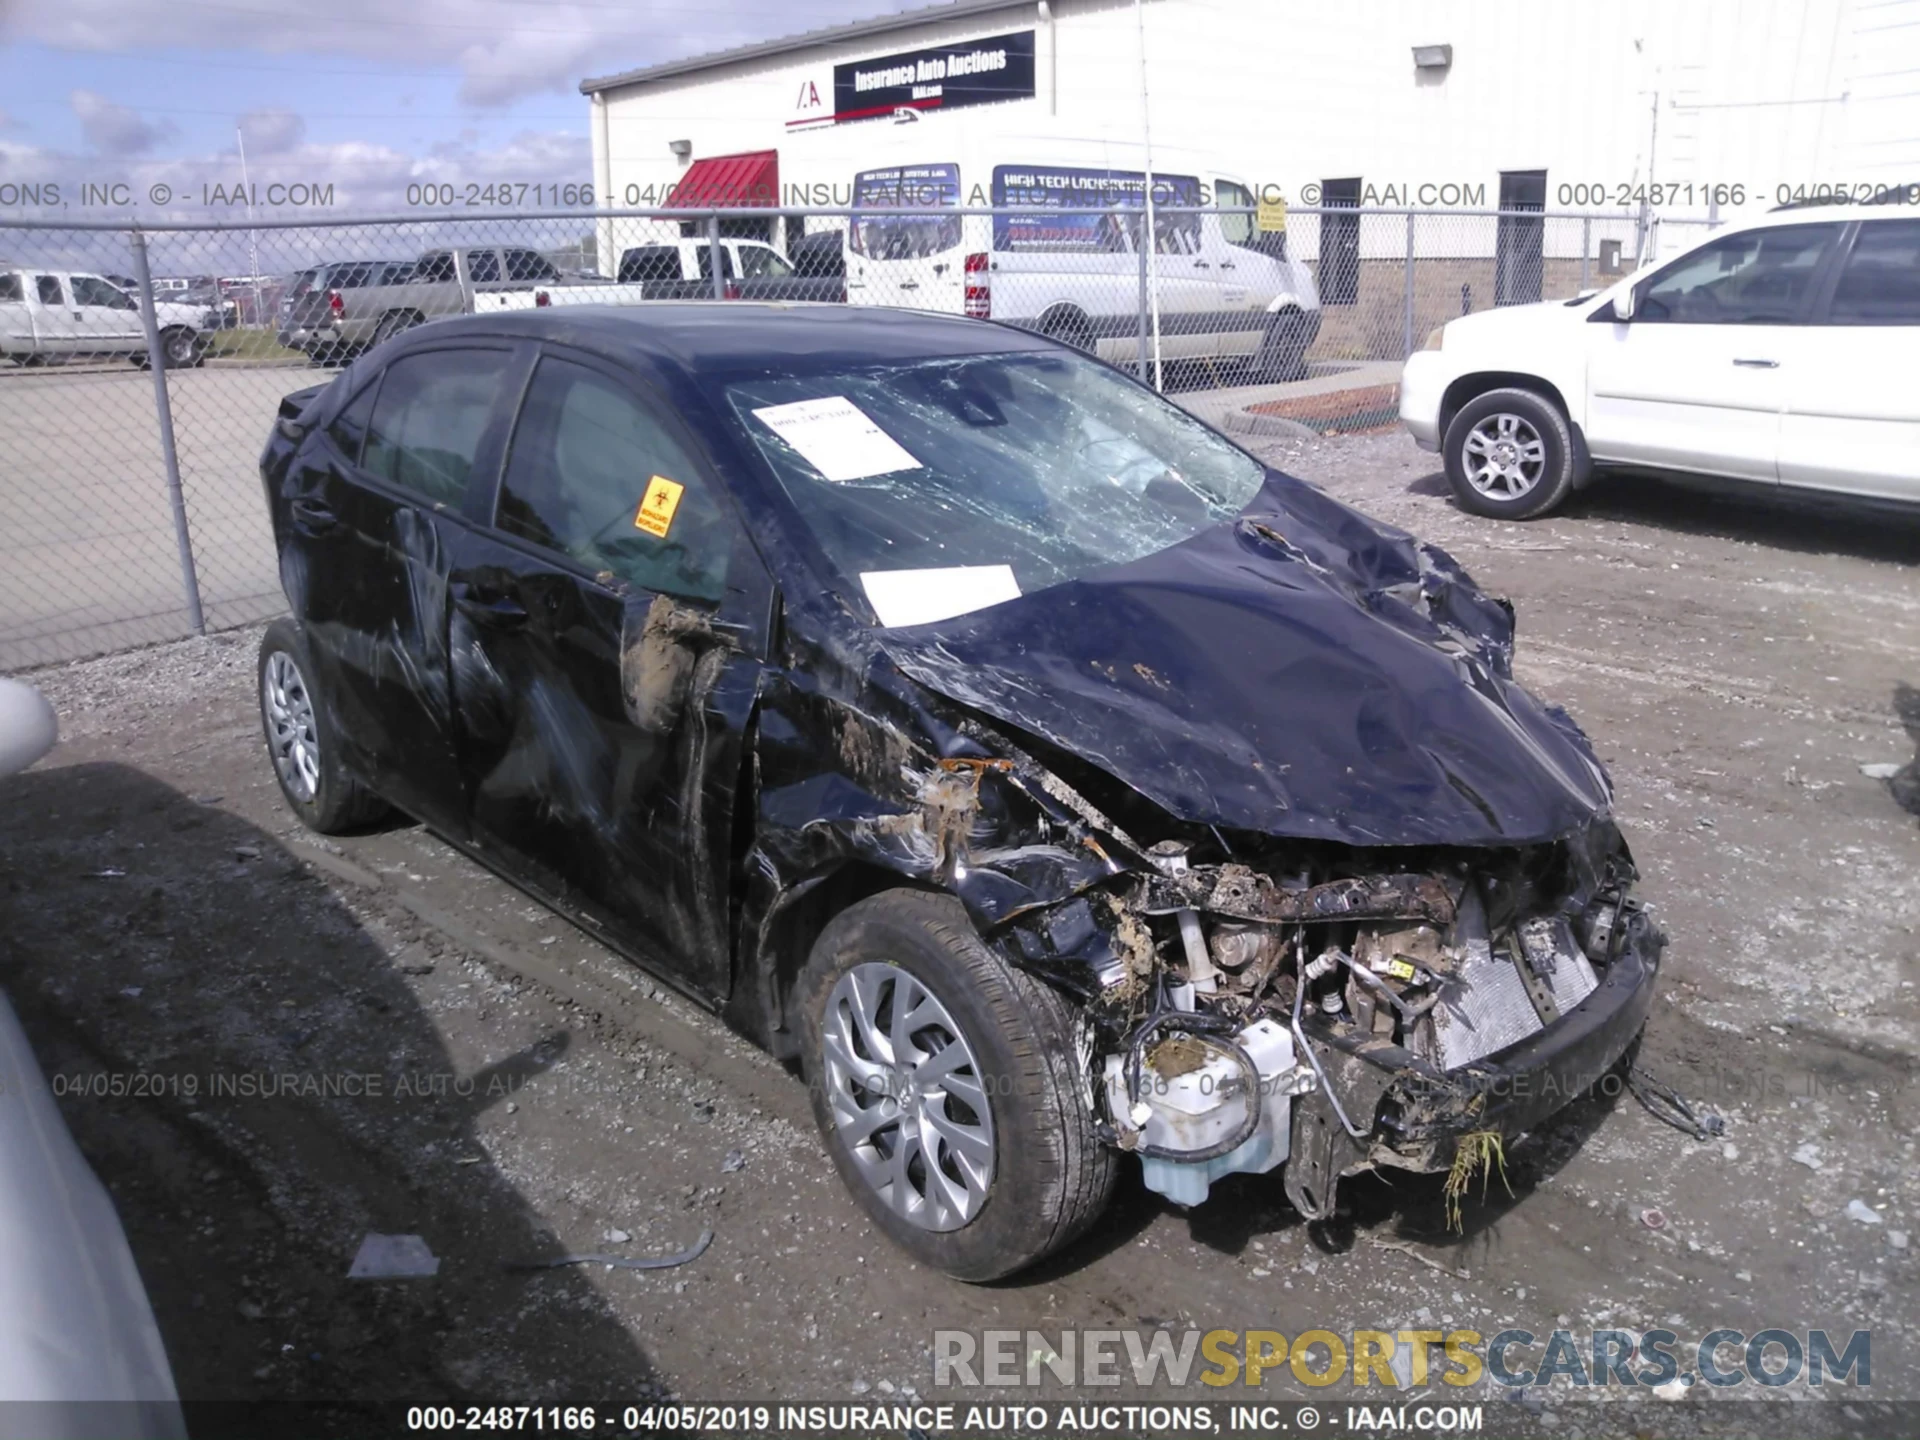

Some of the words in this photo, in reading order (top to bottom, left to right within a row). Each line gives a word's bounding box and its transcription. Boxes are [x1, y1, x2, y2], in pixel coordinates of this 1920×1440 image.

[855, 64, 915, 92] Insurance
[917, 59, 946, 82] Auto
[947, 50, 1006, 78] Auctions
[1004, 173, 1035, 187] HIGH
[1036, 175, 1070, 189] TECH
